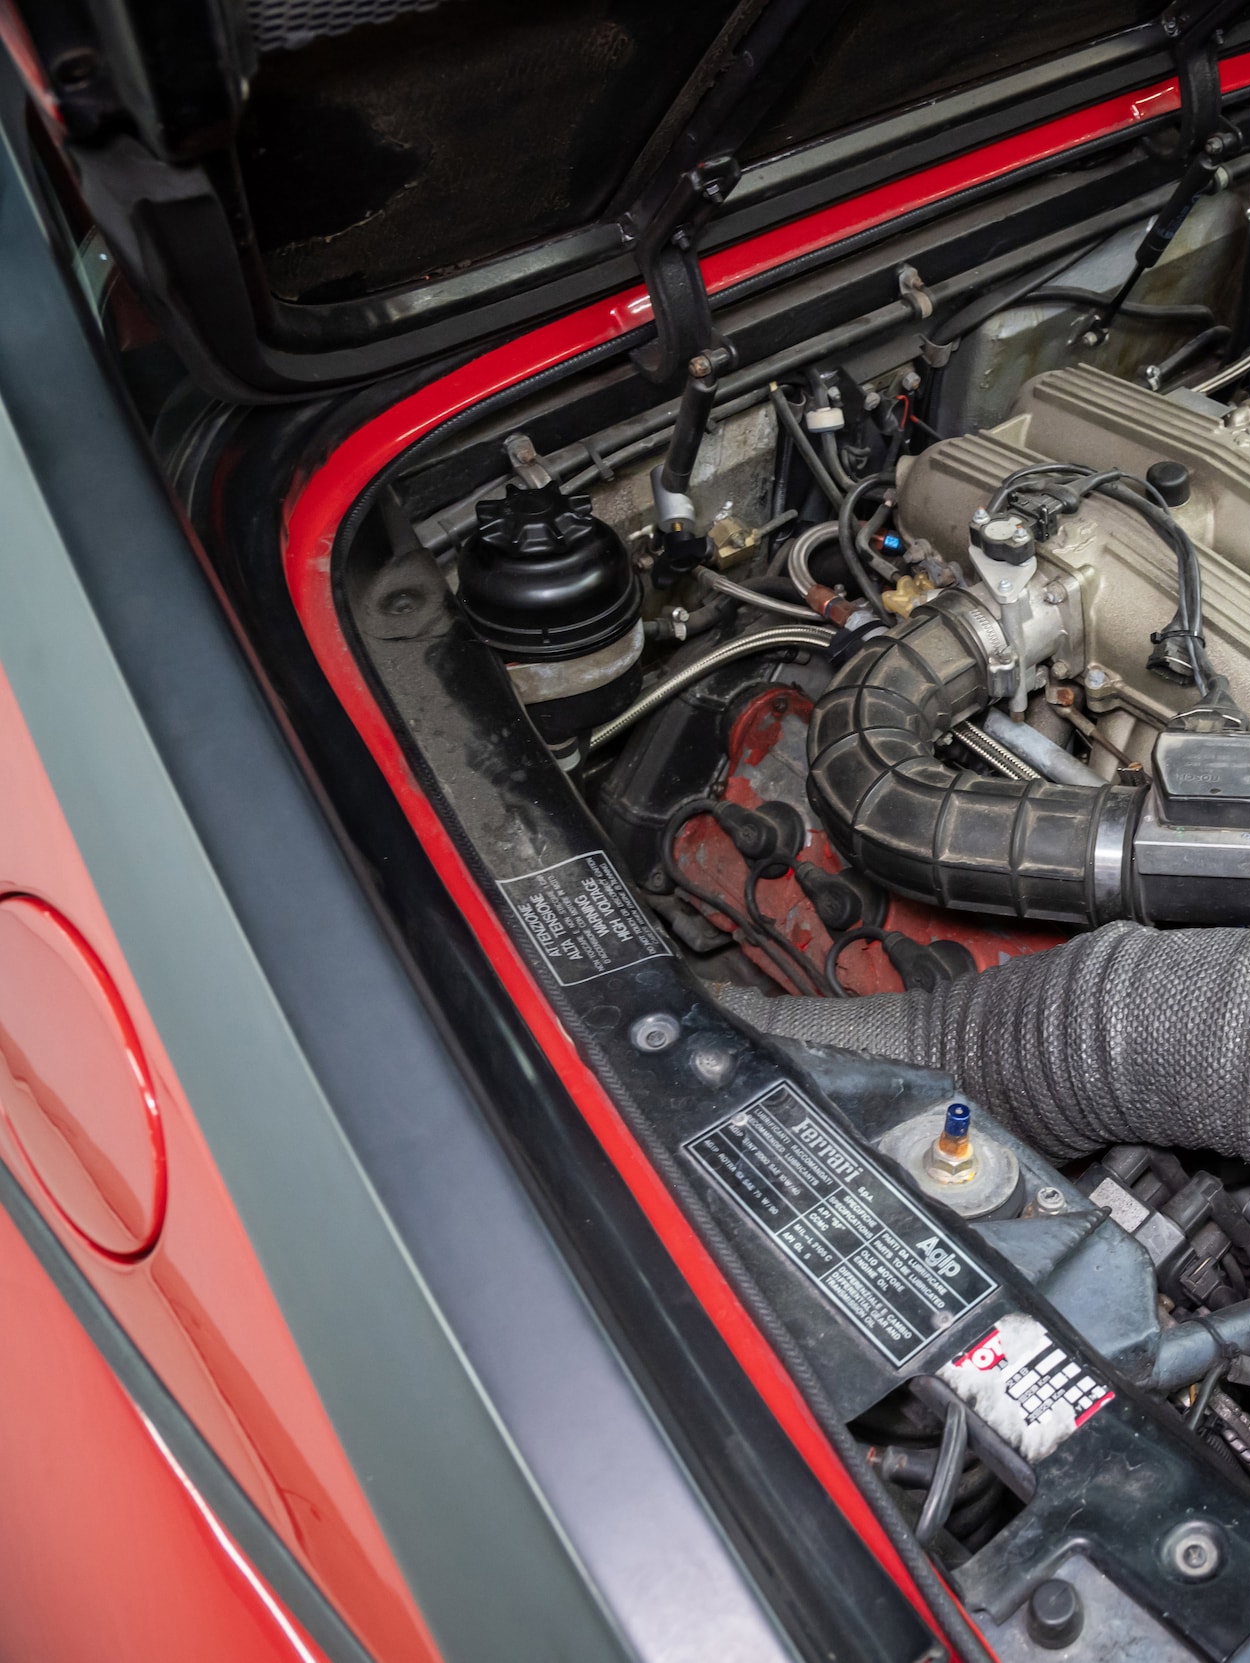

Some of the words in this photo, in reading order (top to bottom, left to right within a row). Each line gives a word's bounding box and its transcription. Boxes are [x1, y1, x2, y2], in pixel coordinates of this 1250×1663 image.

[529, 893, 566, 938] TENSIONE
[574, 894, 610, 937] WARNING
[581, 877, 614, 917] VOLTAGE
[517, 903, 562, 956] ATTENZIONE
[560, 938, 583, 960] ALTA
[609, 918, 633, 942] HIGH
[744, 1114, 785, 1152] RECOMMENDED
[784, 1153, 819, 1186] LUBRICANTS
[754, 1109, 791, 1144] LUBRIFICANTI
[791, 1144, 833, 1185] RACCOMANDATI
[791, 1117, 864, 1183] Ferrari
[809, 1213, 829, 1231] CCMC
[817, 1207, 831, 1219] API
[829, 1196, 873, 1239] SPECIFICATIONS
[843, 1196, 877, 1227] SPECIFICHE
[782, 1232, 796, 1243] API
[915, 1236, 961, 1277] Agip
[853, 1256, 878, 1279] ENGINE
[877, 1278, 888, 1291] OIL
[861, 1250, 878, 1266] OLIO
[877, 1266, 905, 1292] MOTORE
[873, 1240, 893, 1259] PARTS
[908, 1274, 945, 1308] LUBRICATED
[882, 1233, 901, 1251] PARTI
[898, 1249, 909, 1260] DA
[908, 1258, 947, 1295] LUBRIFICARE
[826, 1276, 867, 1318] TRANSMISSION
[864, 1316, 875, 1328] OIL
[831, 1271, 871, 1311] DIFFERENTIAL
[870, 1310, 888, 1327] GEAR
[885, 1326, 901, 1340] AND
[838, 1266, 882, 1312] DIFFERENZIALE
[886, 1314, 912, 1339] CAMBIO
